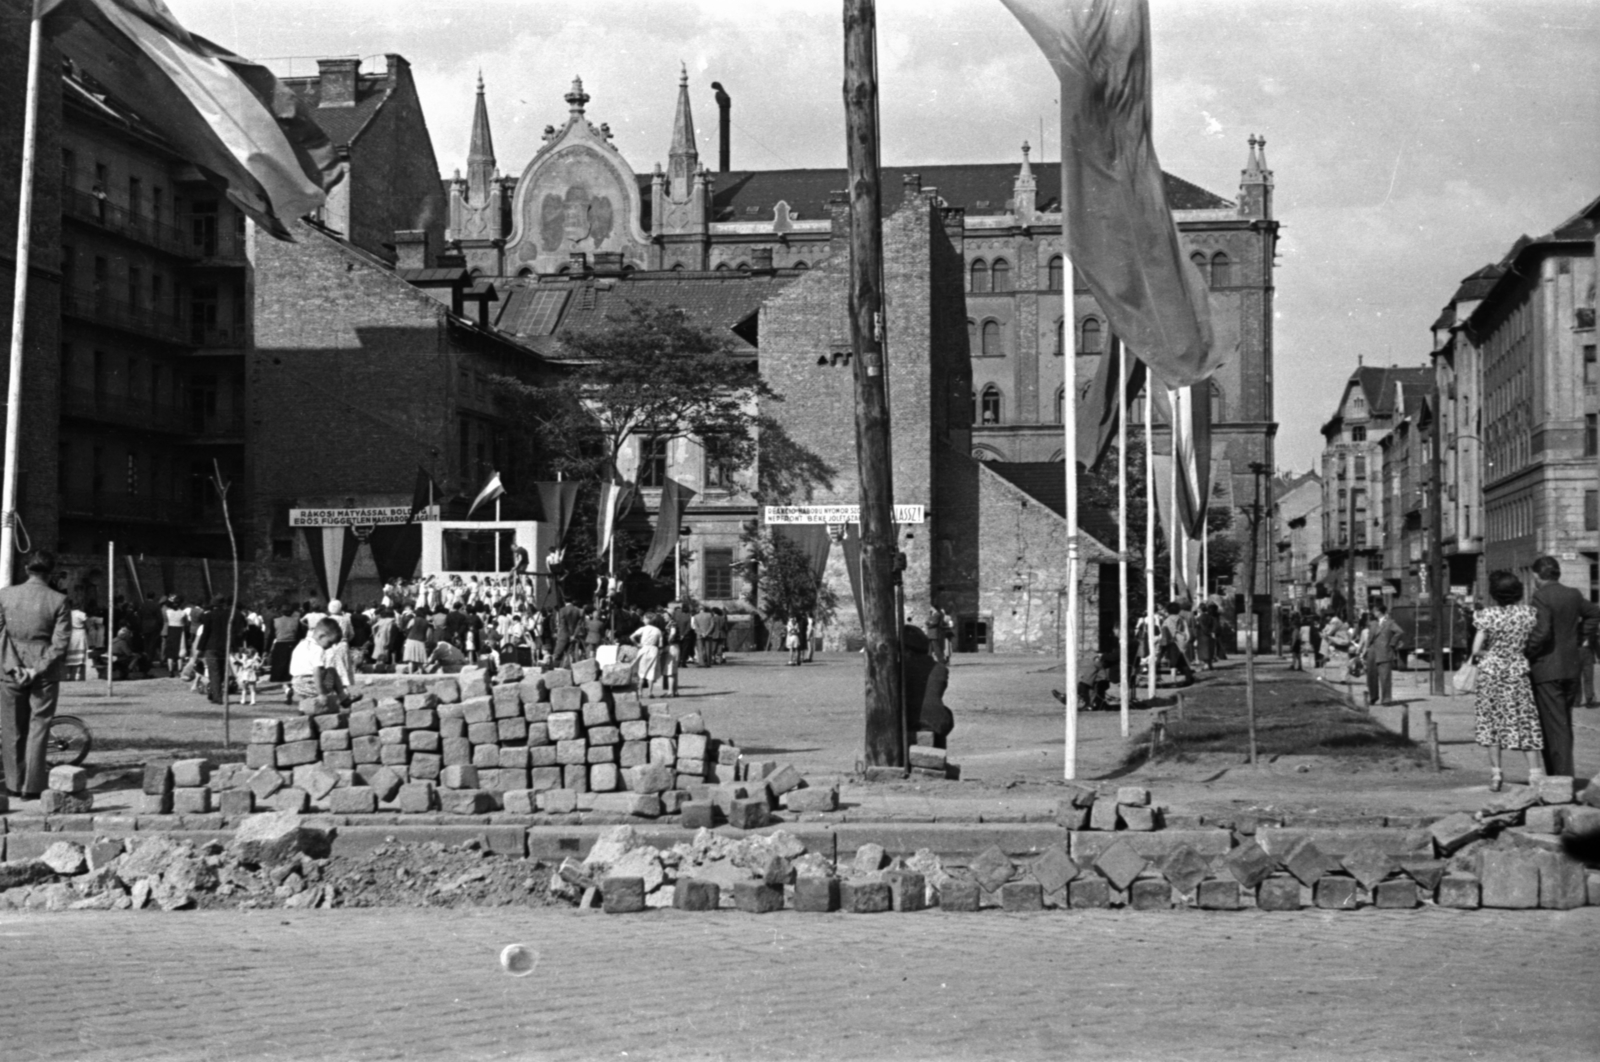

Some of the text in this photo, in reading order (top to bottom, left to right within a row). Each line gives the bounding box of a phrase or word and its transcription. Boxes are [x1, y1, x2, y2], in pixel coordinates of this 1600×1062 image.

[300, 507, 427, 517] RÁKOSI MÁTYÁSSAL BOLDG
